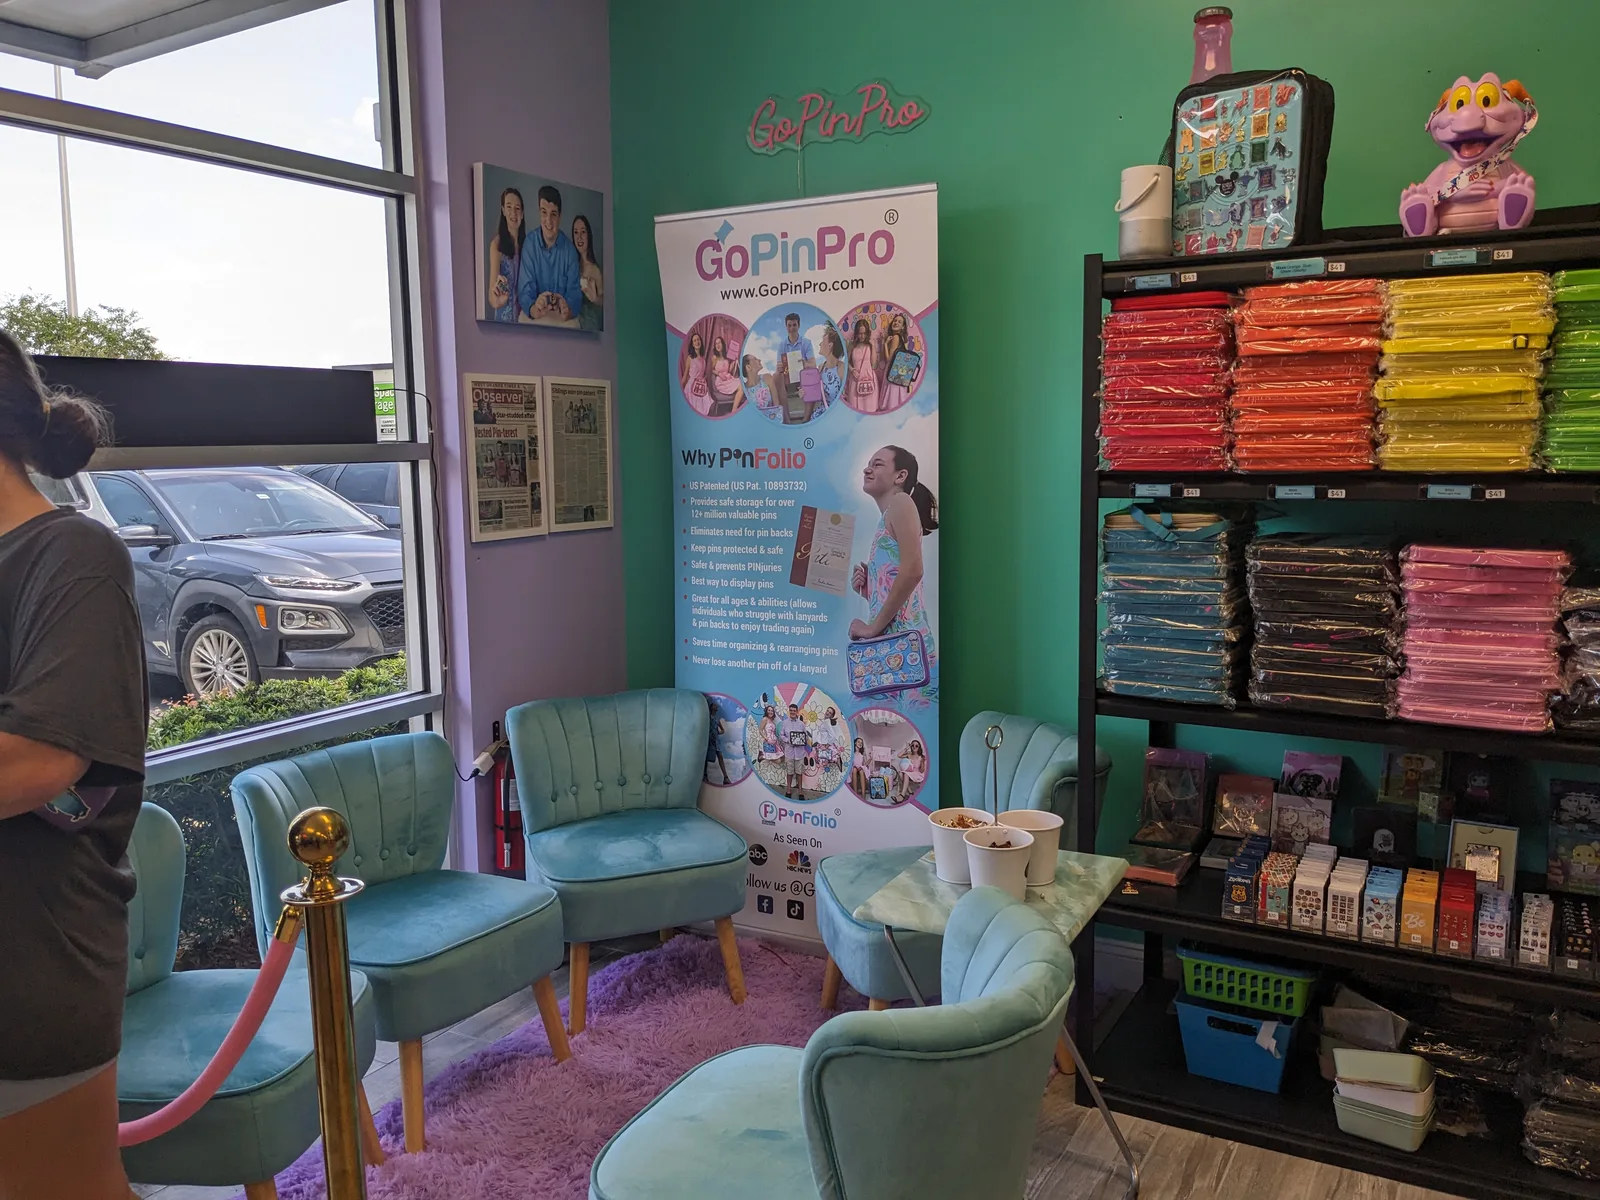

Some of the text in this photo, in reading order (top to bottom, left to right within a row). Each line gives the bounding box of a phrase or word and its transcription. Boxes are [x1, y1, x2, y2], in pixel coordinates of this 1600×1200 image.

[750, 83, 924, 150] GoPinPro
[695, 225, 896, 282] GoPinPro
[720, 276, 865, 300] www.GoPinPro.com
[473, 389, 522, 404] Observer
[682, 449, 716, 469] Why
[689, 481, 807, 492] US Patented (US Pat. 10893732)
[690, 497, 796, 509] Provides safe storage for over
[691, 509, 778, 520] 12+ million valuable pins
[690, 526, 794, 539] Eliminates need for pin backs
[690, 543, 784, 555] Keep pins protected & safe
[691, 560, 782, 573] Safer & prevents PINjuries
[691, 576, 775, 590] Best way to display pins
[691, 593, 817, 609] Great for all ages & abilities (allows
[691, 605, 828, 623] individuals who struggle with lanyards
[692, 619, 815, 636] & pin backs to enjoy trading again)
[692, 637, 839, 657] Saves time organizing & rearranging pins
[692, 655, 828, 675] Never lose another pin off of a lanyard
[773, 832, 822, 848] As Seen On
[749, 849, 768, 860] abc
[786, 865, 812, 875] NBC NEWS
[773, 881, 787, 893] us
